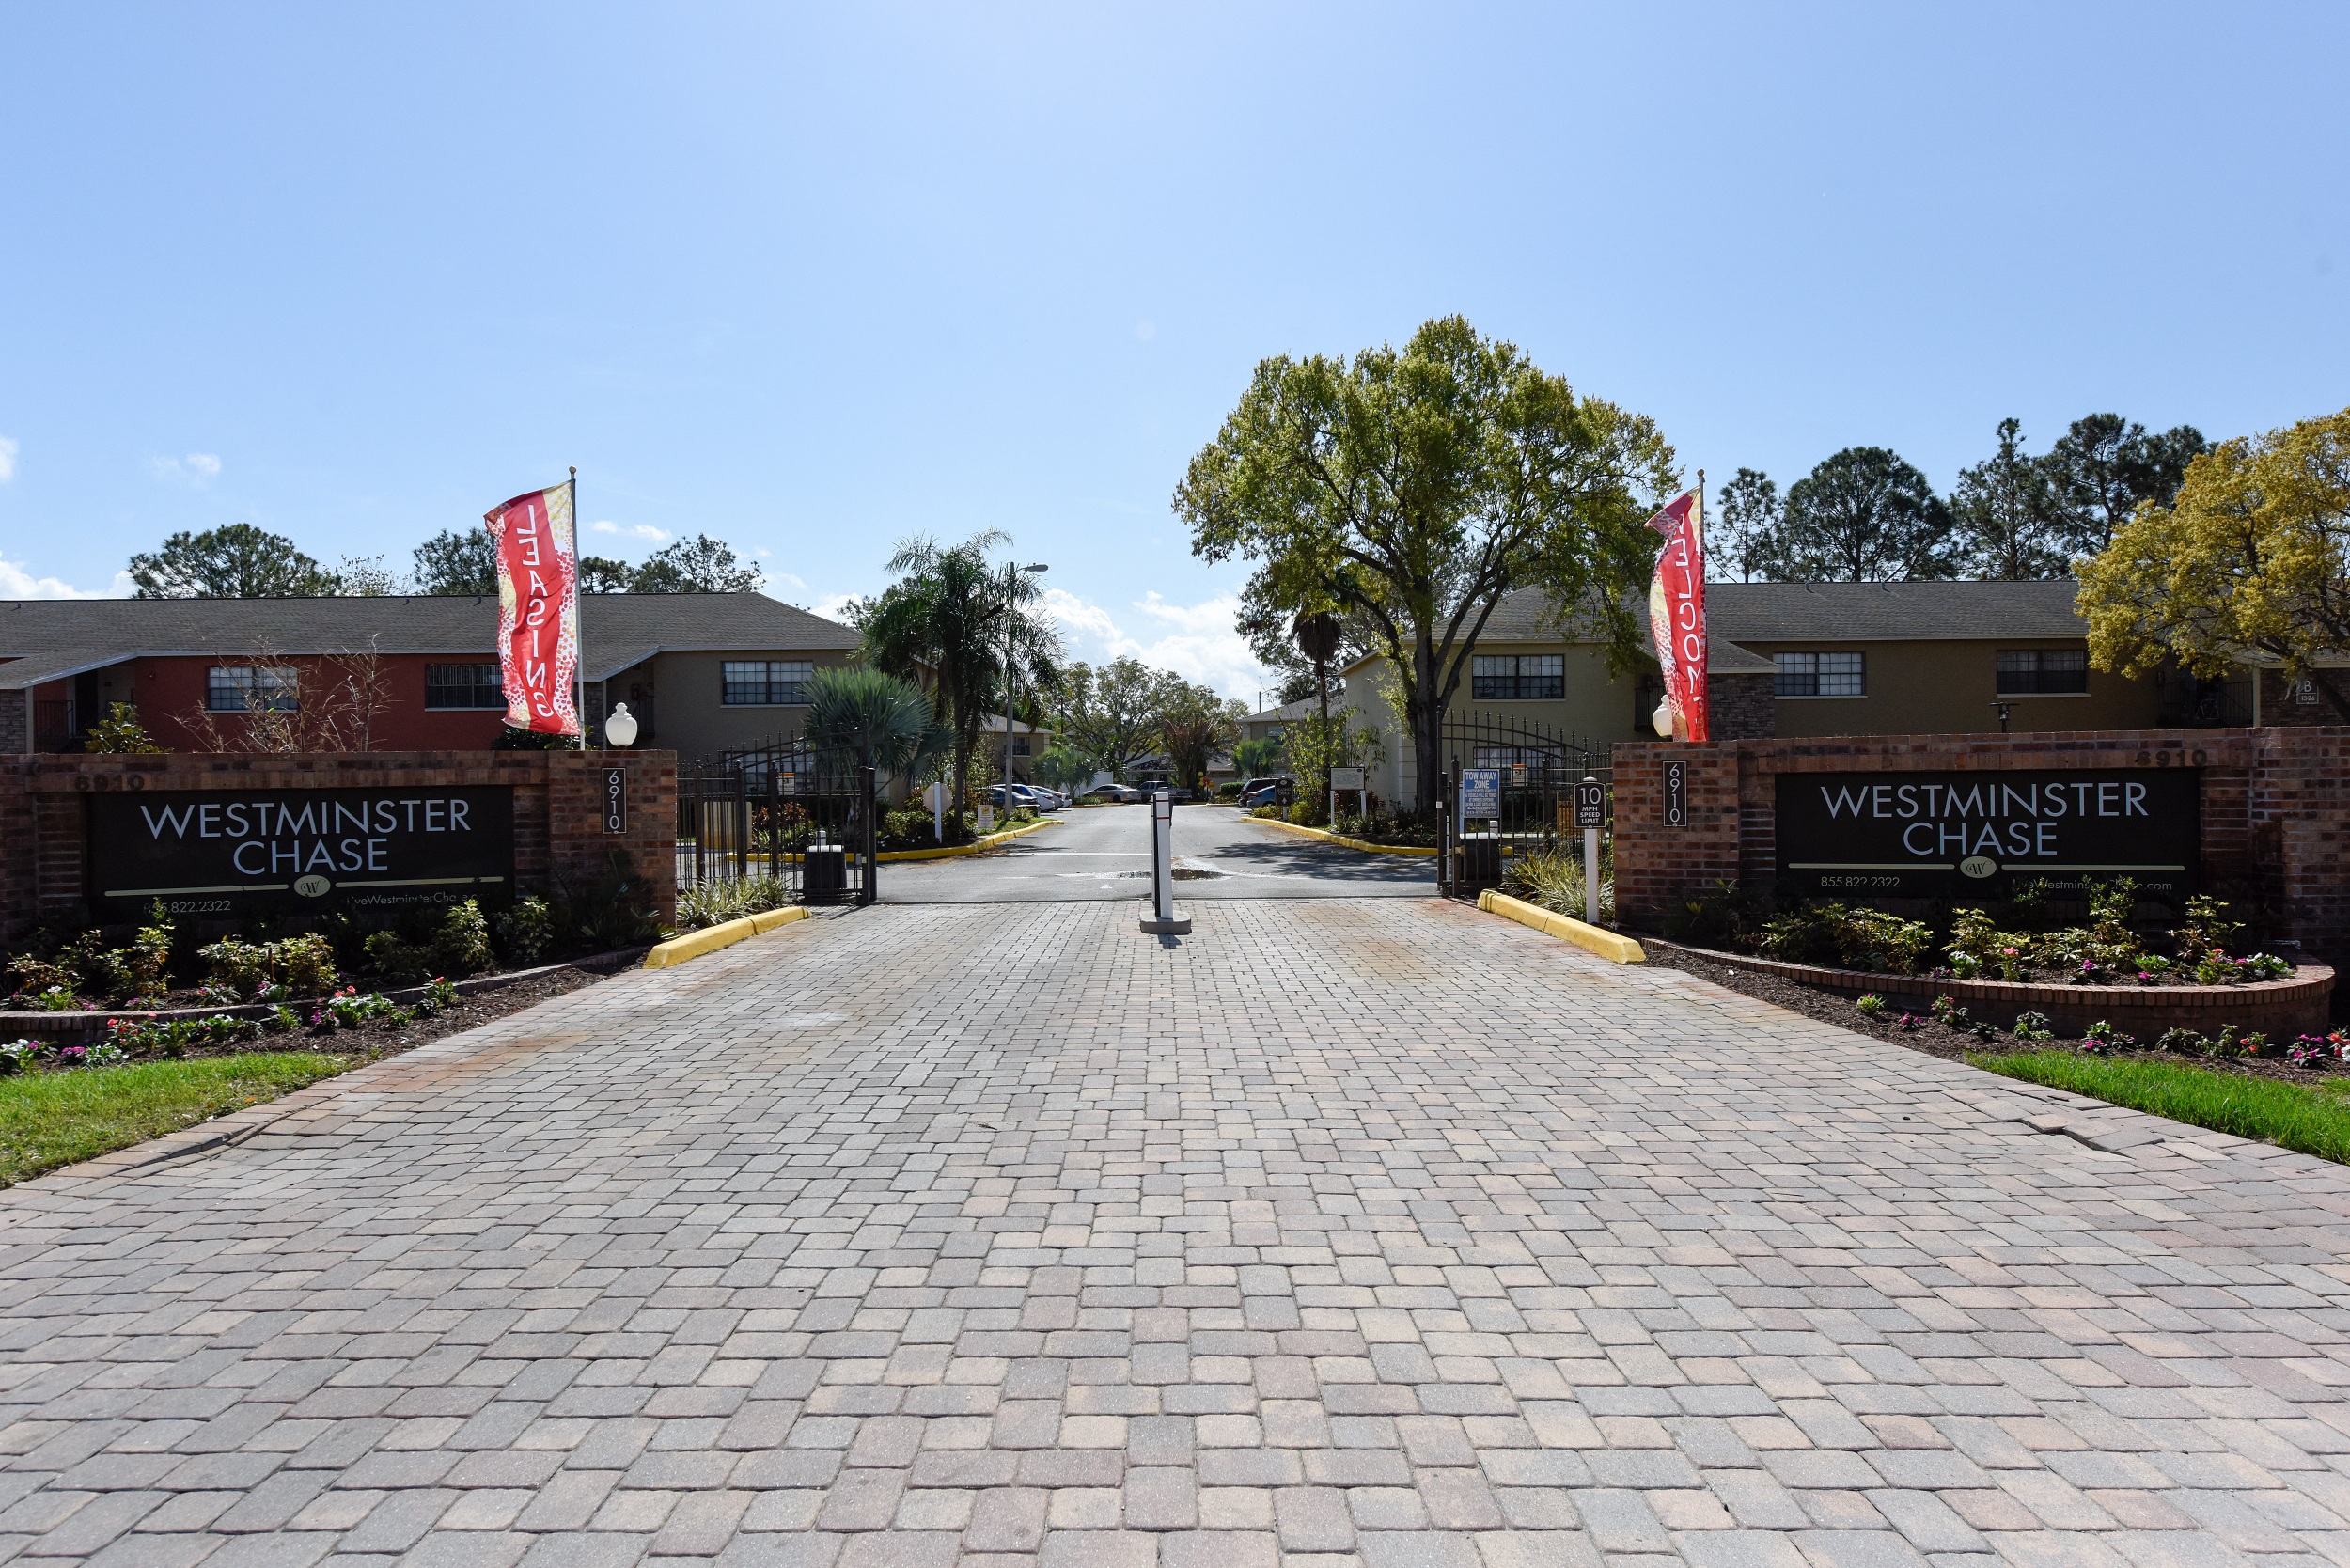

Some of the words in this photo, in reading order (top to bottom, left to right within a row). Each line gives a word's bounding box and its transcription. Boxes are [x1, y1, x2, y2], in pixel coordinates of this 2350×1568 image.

[2304, 680, 2312, 693] B
[2132, 749, 2207, 768] 6910
[74, 774, 145, 792] 6910
[1465, 771, 1479, 780] TOW
[1480, 771, 1497, 780] AWAY
[1474, 780, 1490, 789] ZONE
[609, 770, 620, 830] 6910
[1580, 787, 1602, 805] 10
[1669, 763, 1681, 823] 6910
[1820, 782, 2149, 819] WESTMINSTER
[140, 799, 472, 839] WESTMINSTER
[1903, 821, 2058, 855] CHASE
[233, 837, 388, 875] CHASE
[1821, 876, 1901, 887] 855.822.2322
